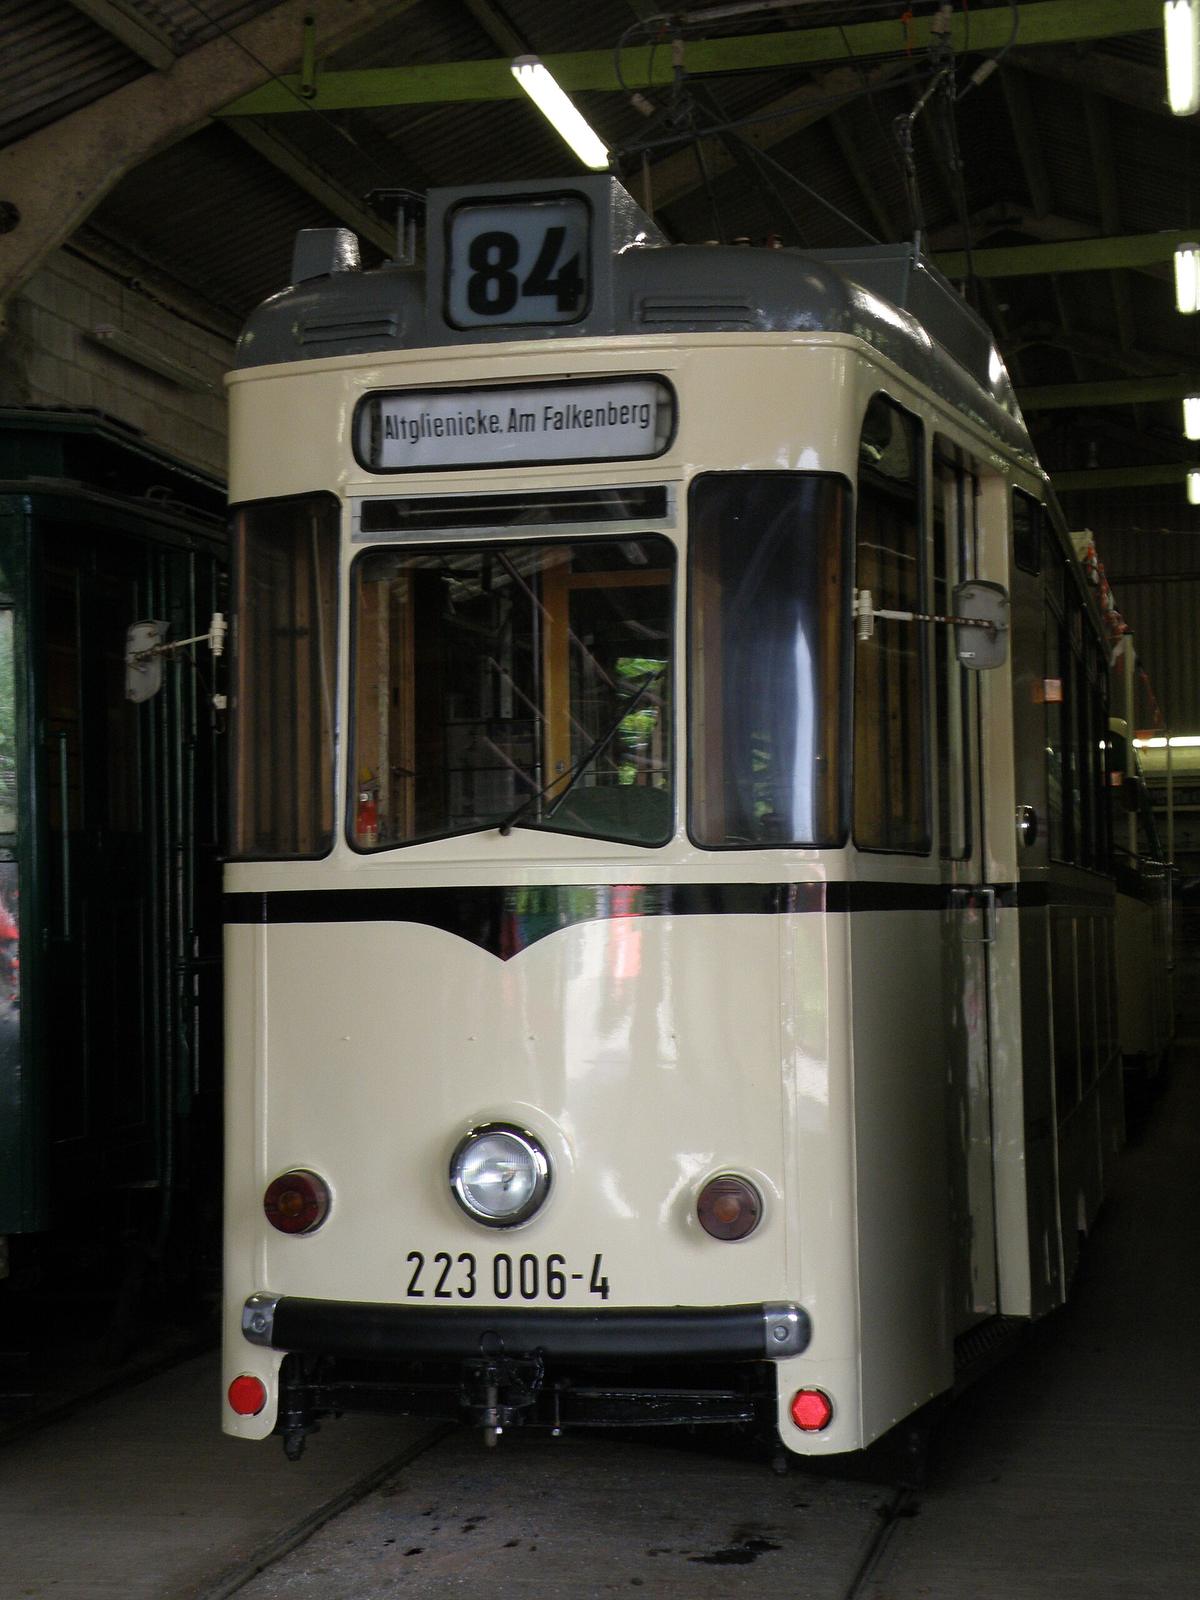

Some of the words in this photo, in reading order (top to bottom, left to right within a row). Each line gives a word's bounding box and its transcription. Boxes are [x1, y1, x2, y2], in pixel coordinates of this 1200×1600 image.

[468, 227, 583, 315] 84
[507, 407, 536, 433] Am
[543, 401, 650, 429] Falkenberg
[406, 1251, 477, 1299] 223
[493, 1253, 610, 1300] 006-4
